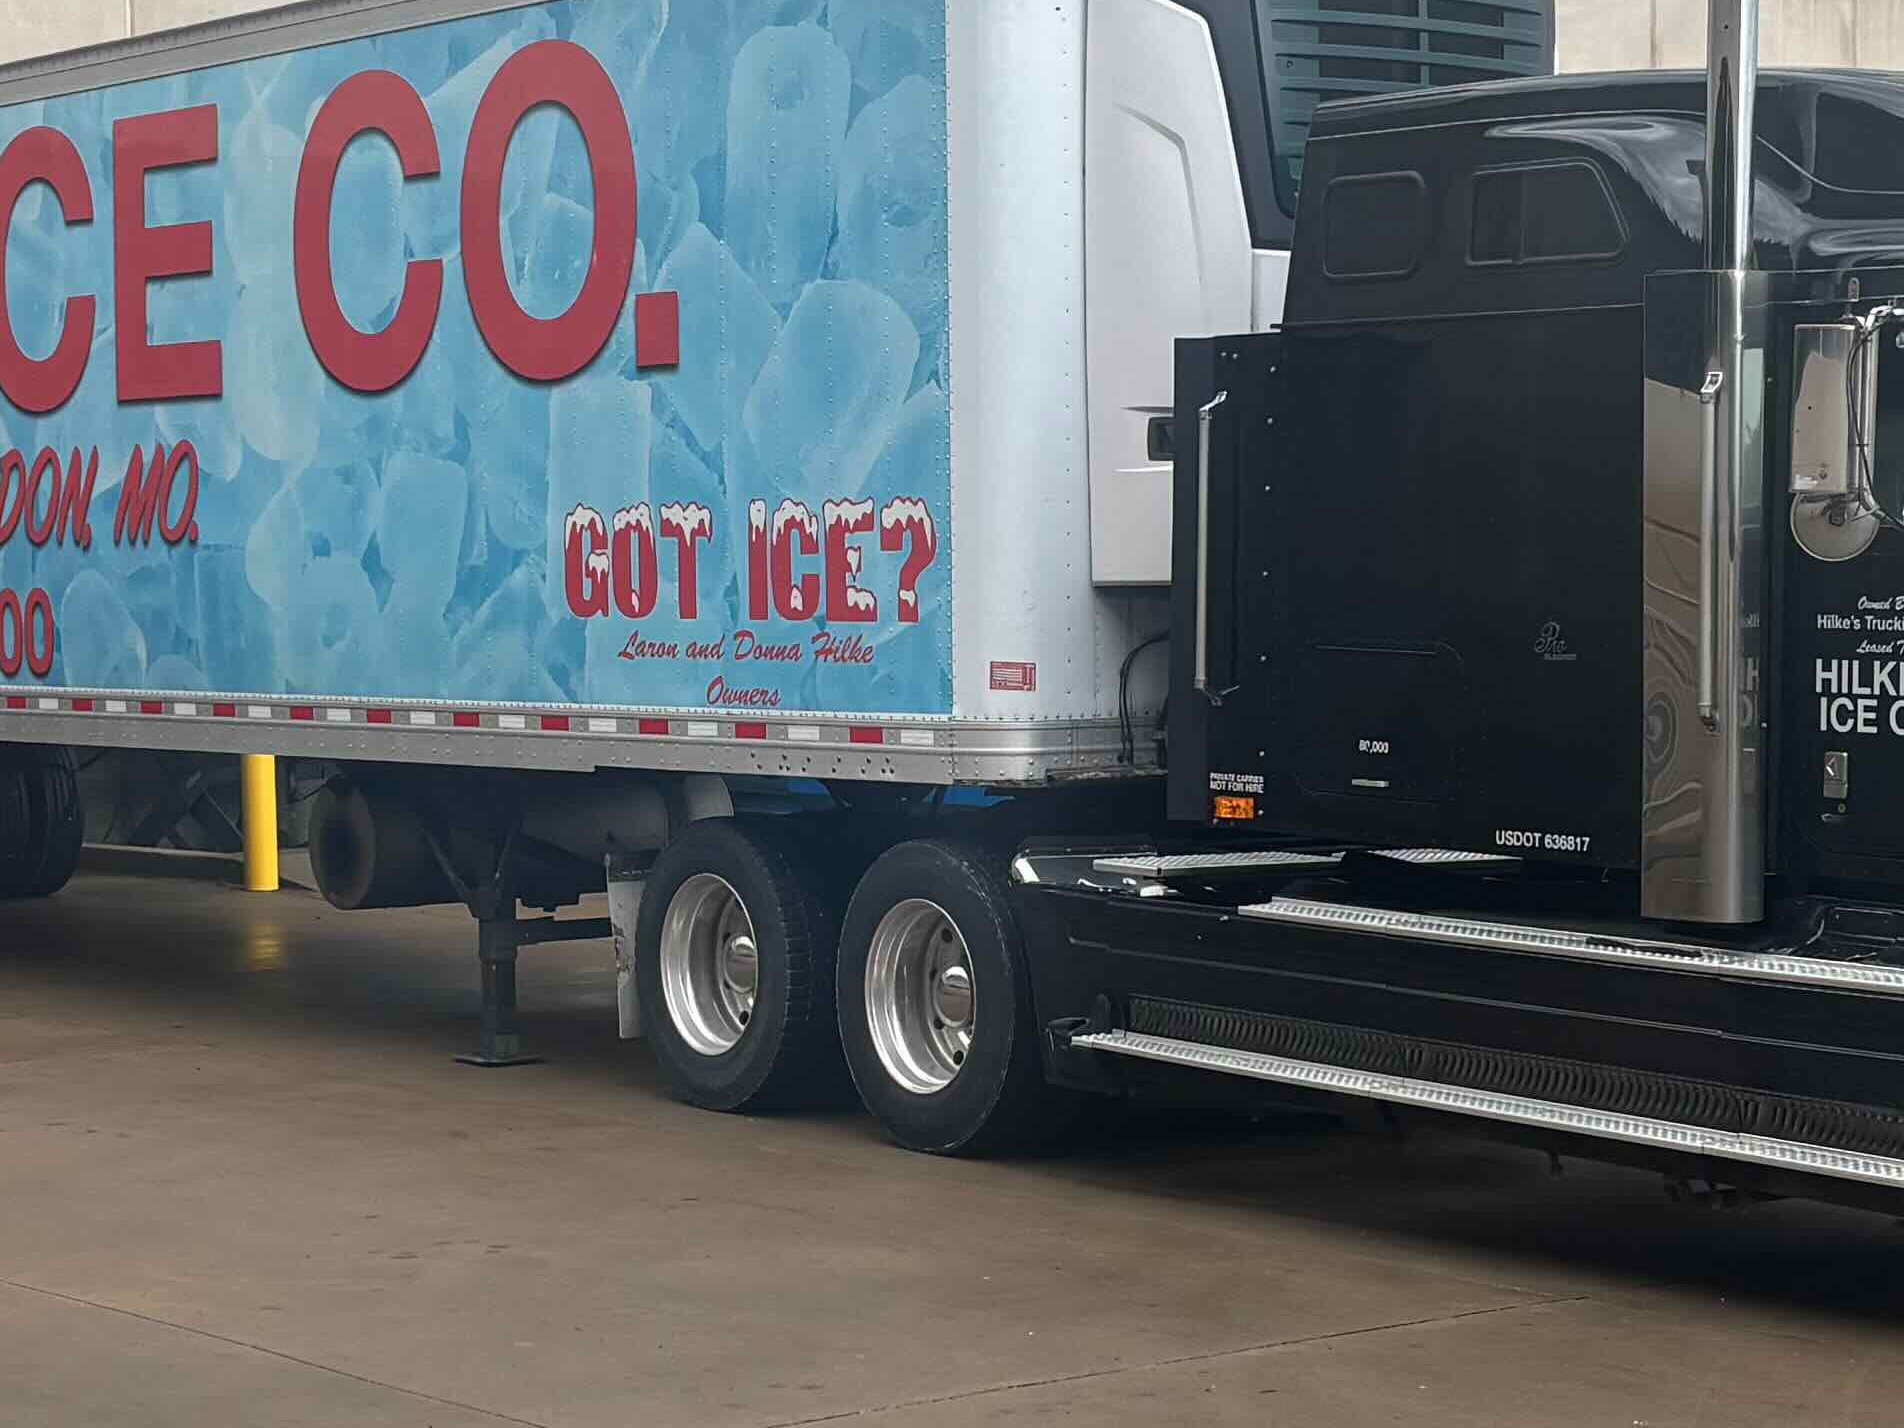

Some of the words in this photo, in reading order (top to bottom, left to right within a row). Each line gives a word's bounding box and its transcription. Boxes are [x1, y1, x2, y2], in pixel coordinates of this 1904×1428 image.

[293, 38, 680, 393] CO.
[113, 438, 200, 548] MO.
[563, 501, 713, 621] GOT
[747, 496, 938, 623] ICE?
[1857, 595, 1894, 610] Owned
[1816, 614, 1862, 631] Hilke's
[616, 629, 680, 663] Laron
[685, 630, 726, 660] and
[734, 628, 803, 664] Donna
[810, 630, 875, 665] Hilke
[1856, 639, 1894, 654] Leased
[705, 674, 782, 708] Owners
[1819, 696, 1878, 734] ICE
[1209, 772, 1235, 782] PRIVATE
[1236, 773, 1264, 784] CARRIER
[1209, 780, 1227, 791] NOT
[1227, 781, 1245, 792] FOR
[1245, 782, 1264, 794] HIRE
[1495, 829, 1542, 848] USDOT
[1544, 833, 1590, 852] 636817
